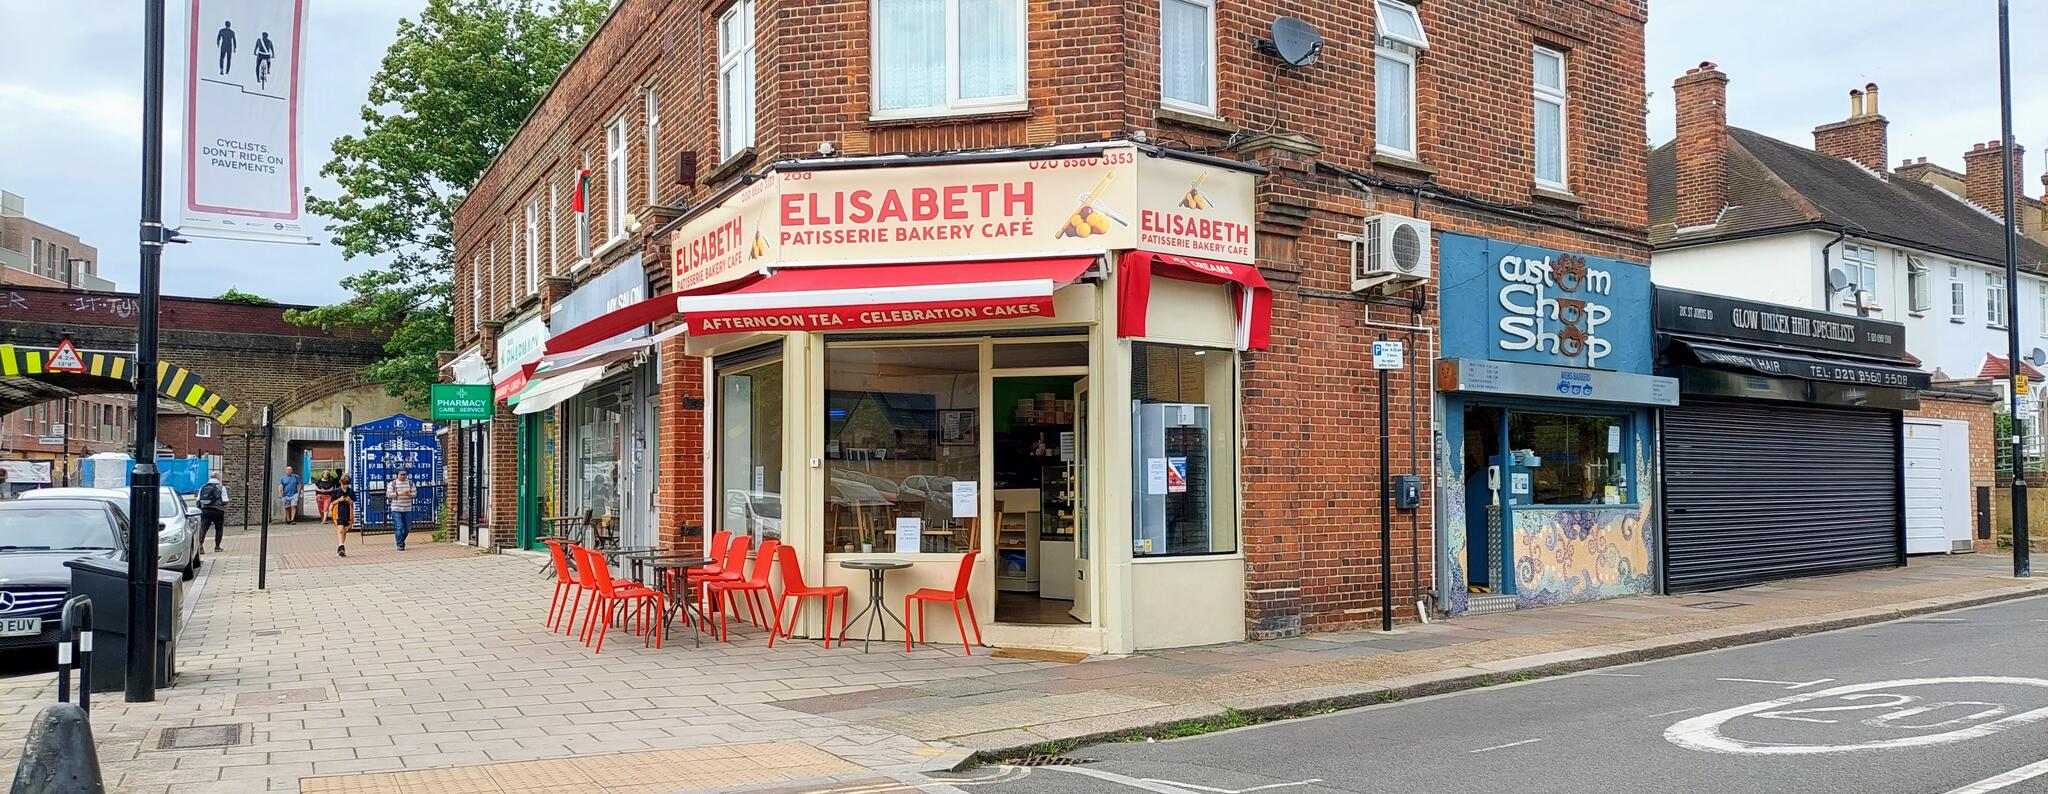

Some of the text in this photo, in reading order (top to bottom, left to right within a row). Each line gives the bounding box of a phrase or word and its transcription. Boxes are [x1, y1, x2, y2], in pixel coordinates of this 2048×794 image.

[203, 147, 284, 165] DON'T RIDE ON
[211, 158, 276, 174] PAVEMENTS
[1102, 152, 1134, 165] 3353
[780, 182, 1034, 227] ELISABETH
[780, 217, 1033, 246] PATISSERIE BAKERY CAFÉ
[1141, 209, 1249, 244] ELISABETH
[676, 215, 742, 277] ELISABETH
[1141, 233, 1191, 248] PATISSERIE
[1192, 240, 1226, 253] BAKERY
[677, 269, 704, 290] PATISSERIE
[705, 260, 726, 281] BAKERY
[1190, 260, 1233, 275] CREAMS
[702, 314, 805, 331] AFTERNOON
[808, 313, 843, 327] TEA
[859, 306, 978, 324] CELEBRATION
[982, 303, 1041, 316] CAKES
[1732, 308, 1856, 343] GLOW UNISEX HAIR SPECIALISTS
[1756, 358, 1781, 373] HAIR
[1809, 365, 1831, 379] TEL:
[1834, 367, 1855, 381] 020
[1885, 373, 1908, 386] 5508
[437, 399, 487, 407] PHARMACY
[8, 620, 34, 631] EUV
